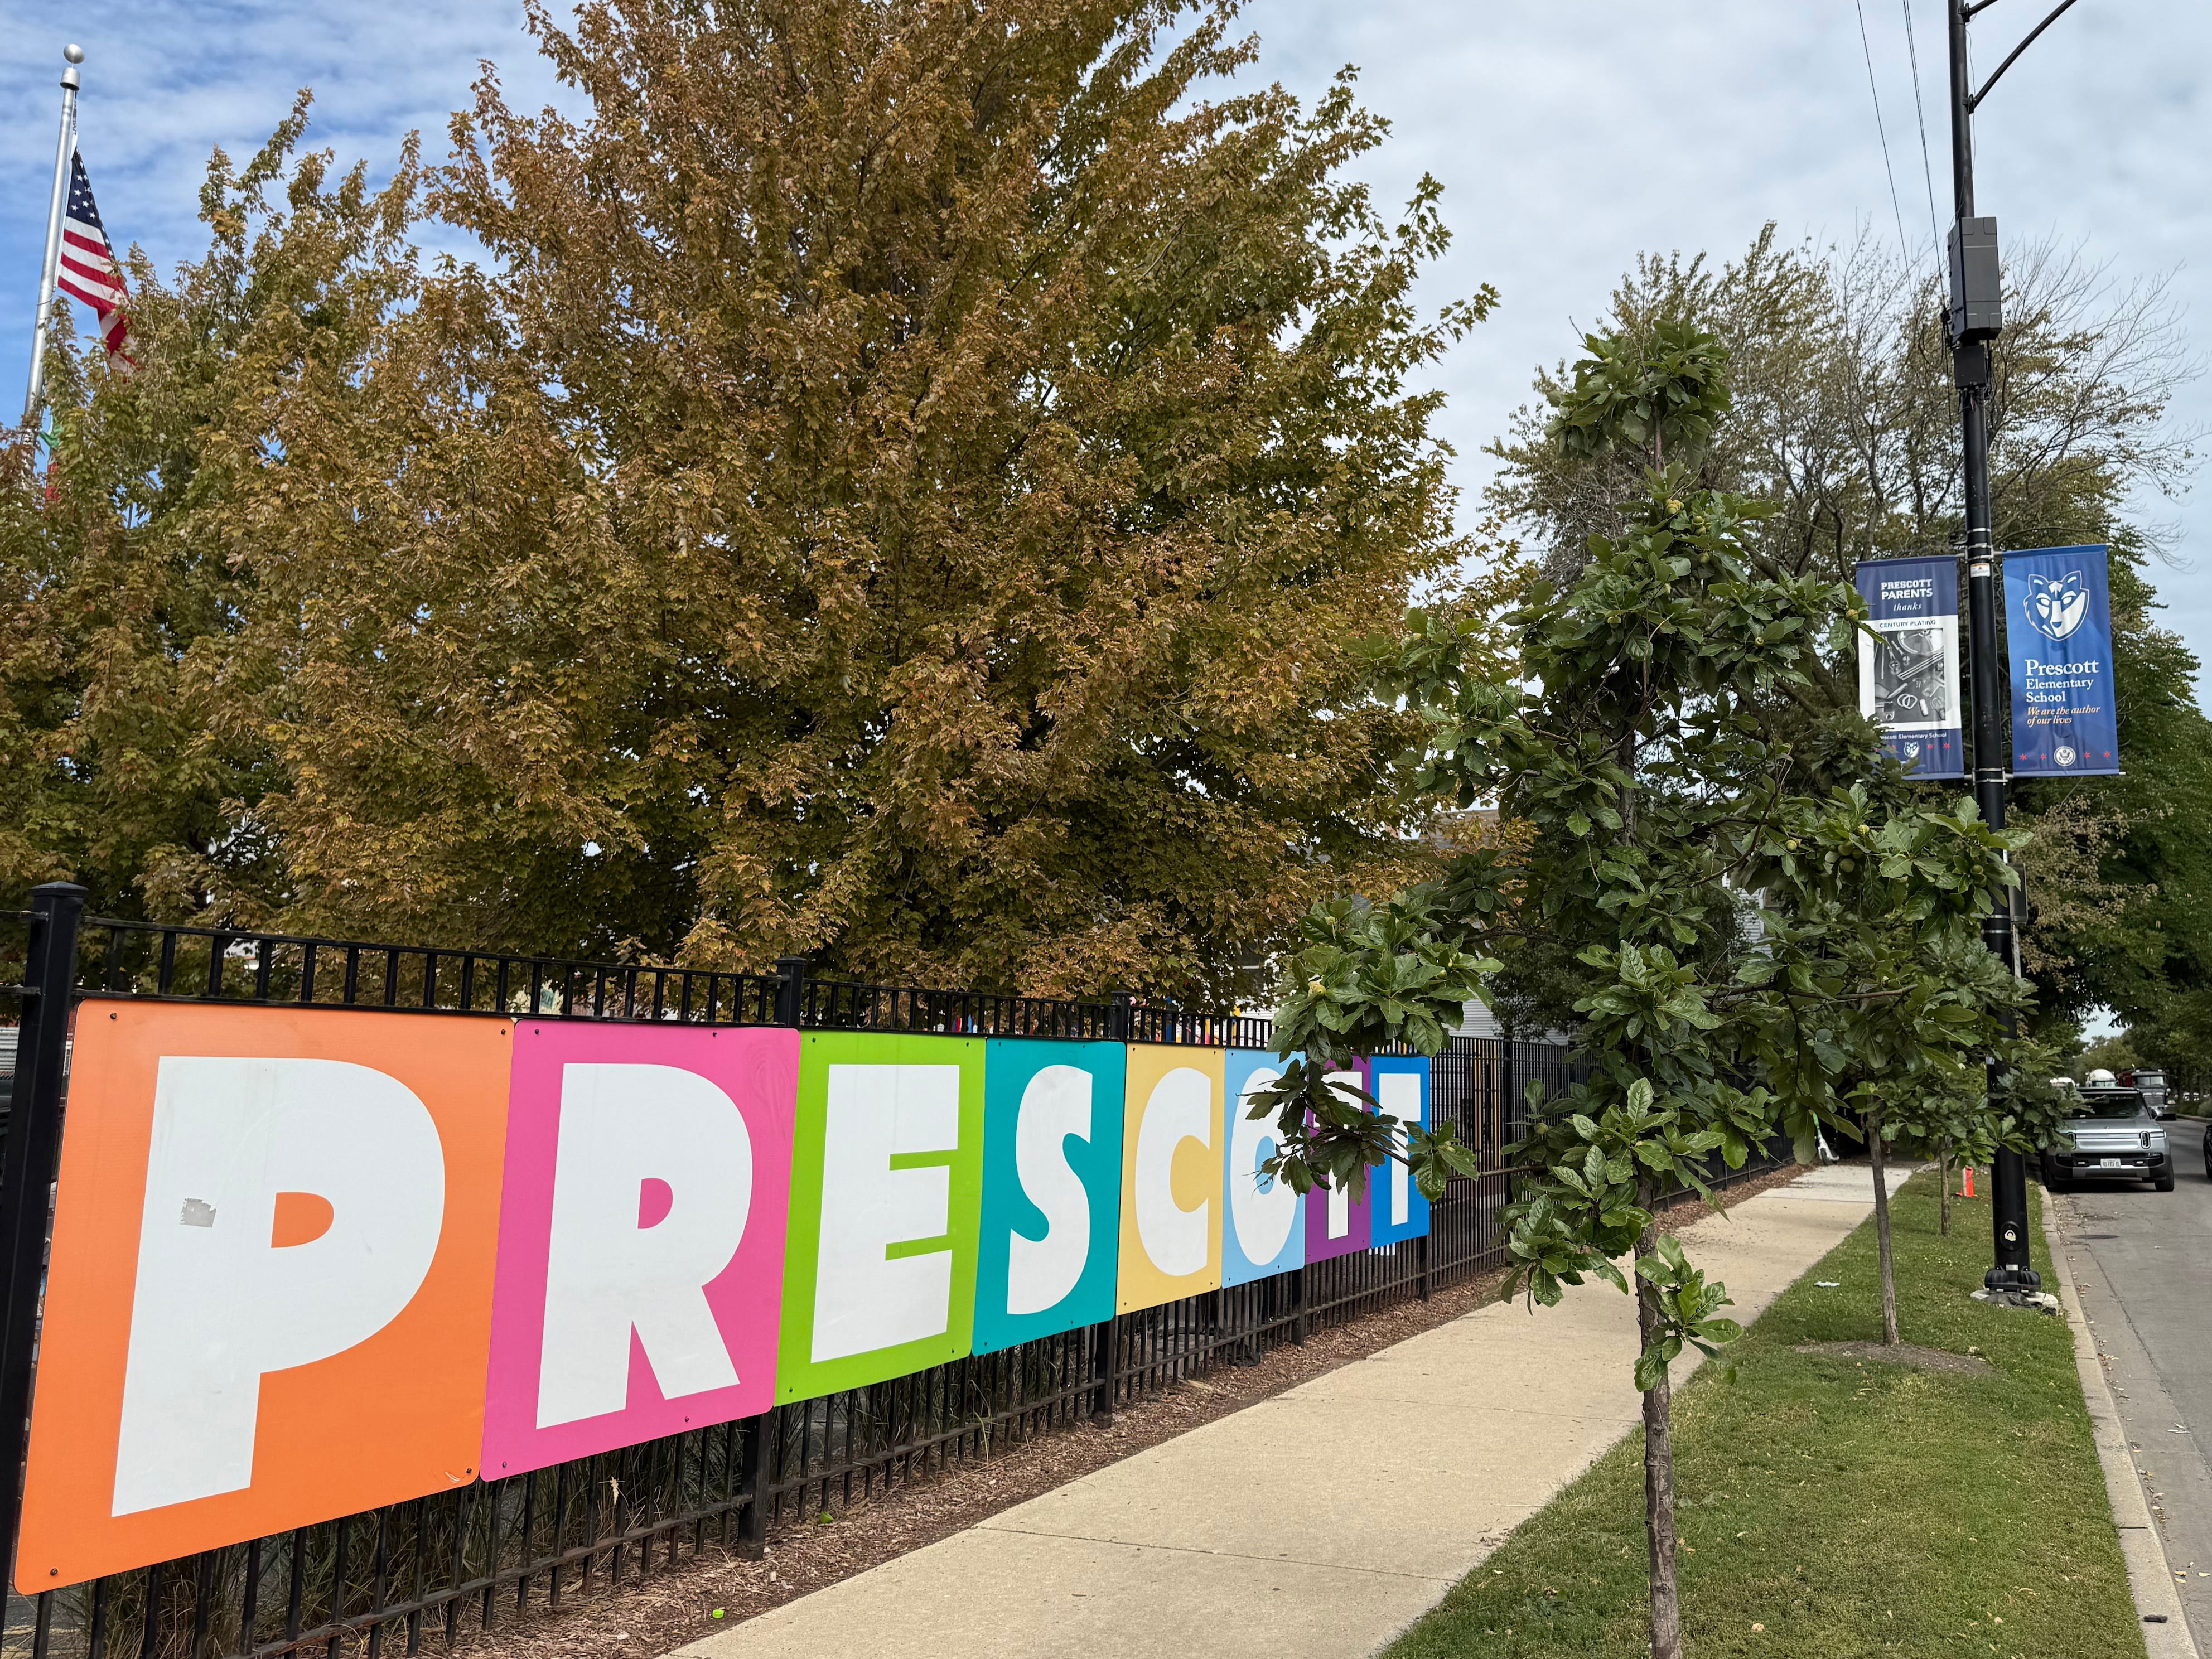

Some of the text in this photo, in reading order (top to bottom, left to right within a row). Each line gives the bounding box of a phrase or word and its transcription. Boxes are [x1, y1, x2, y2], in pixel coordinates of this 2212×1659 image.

[1881, 579, 1933, 590] PRESCOTT
[1881, 588, 1933, 600] PARENTS
[1893, 602, 1922, 611] thanks
[2025, 659, 2099, 676] Prescott
[2026, 678, 2094, 690] Elementary
[2026, 691, 2066, 703] School
[2027, 707, 2040, 715] We
[2056, 706, 2069, 715] the
[2071, 704, 2101, 714] author
[2027, 716, 2037, 728] of
[2052, 715, 2073, 724] lives
